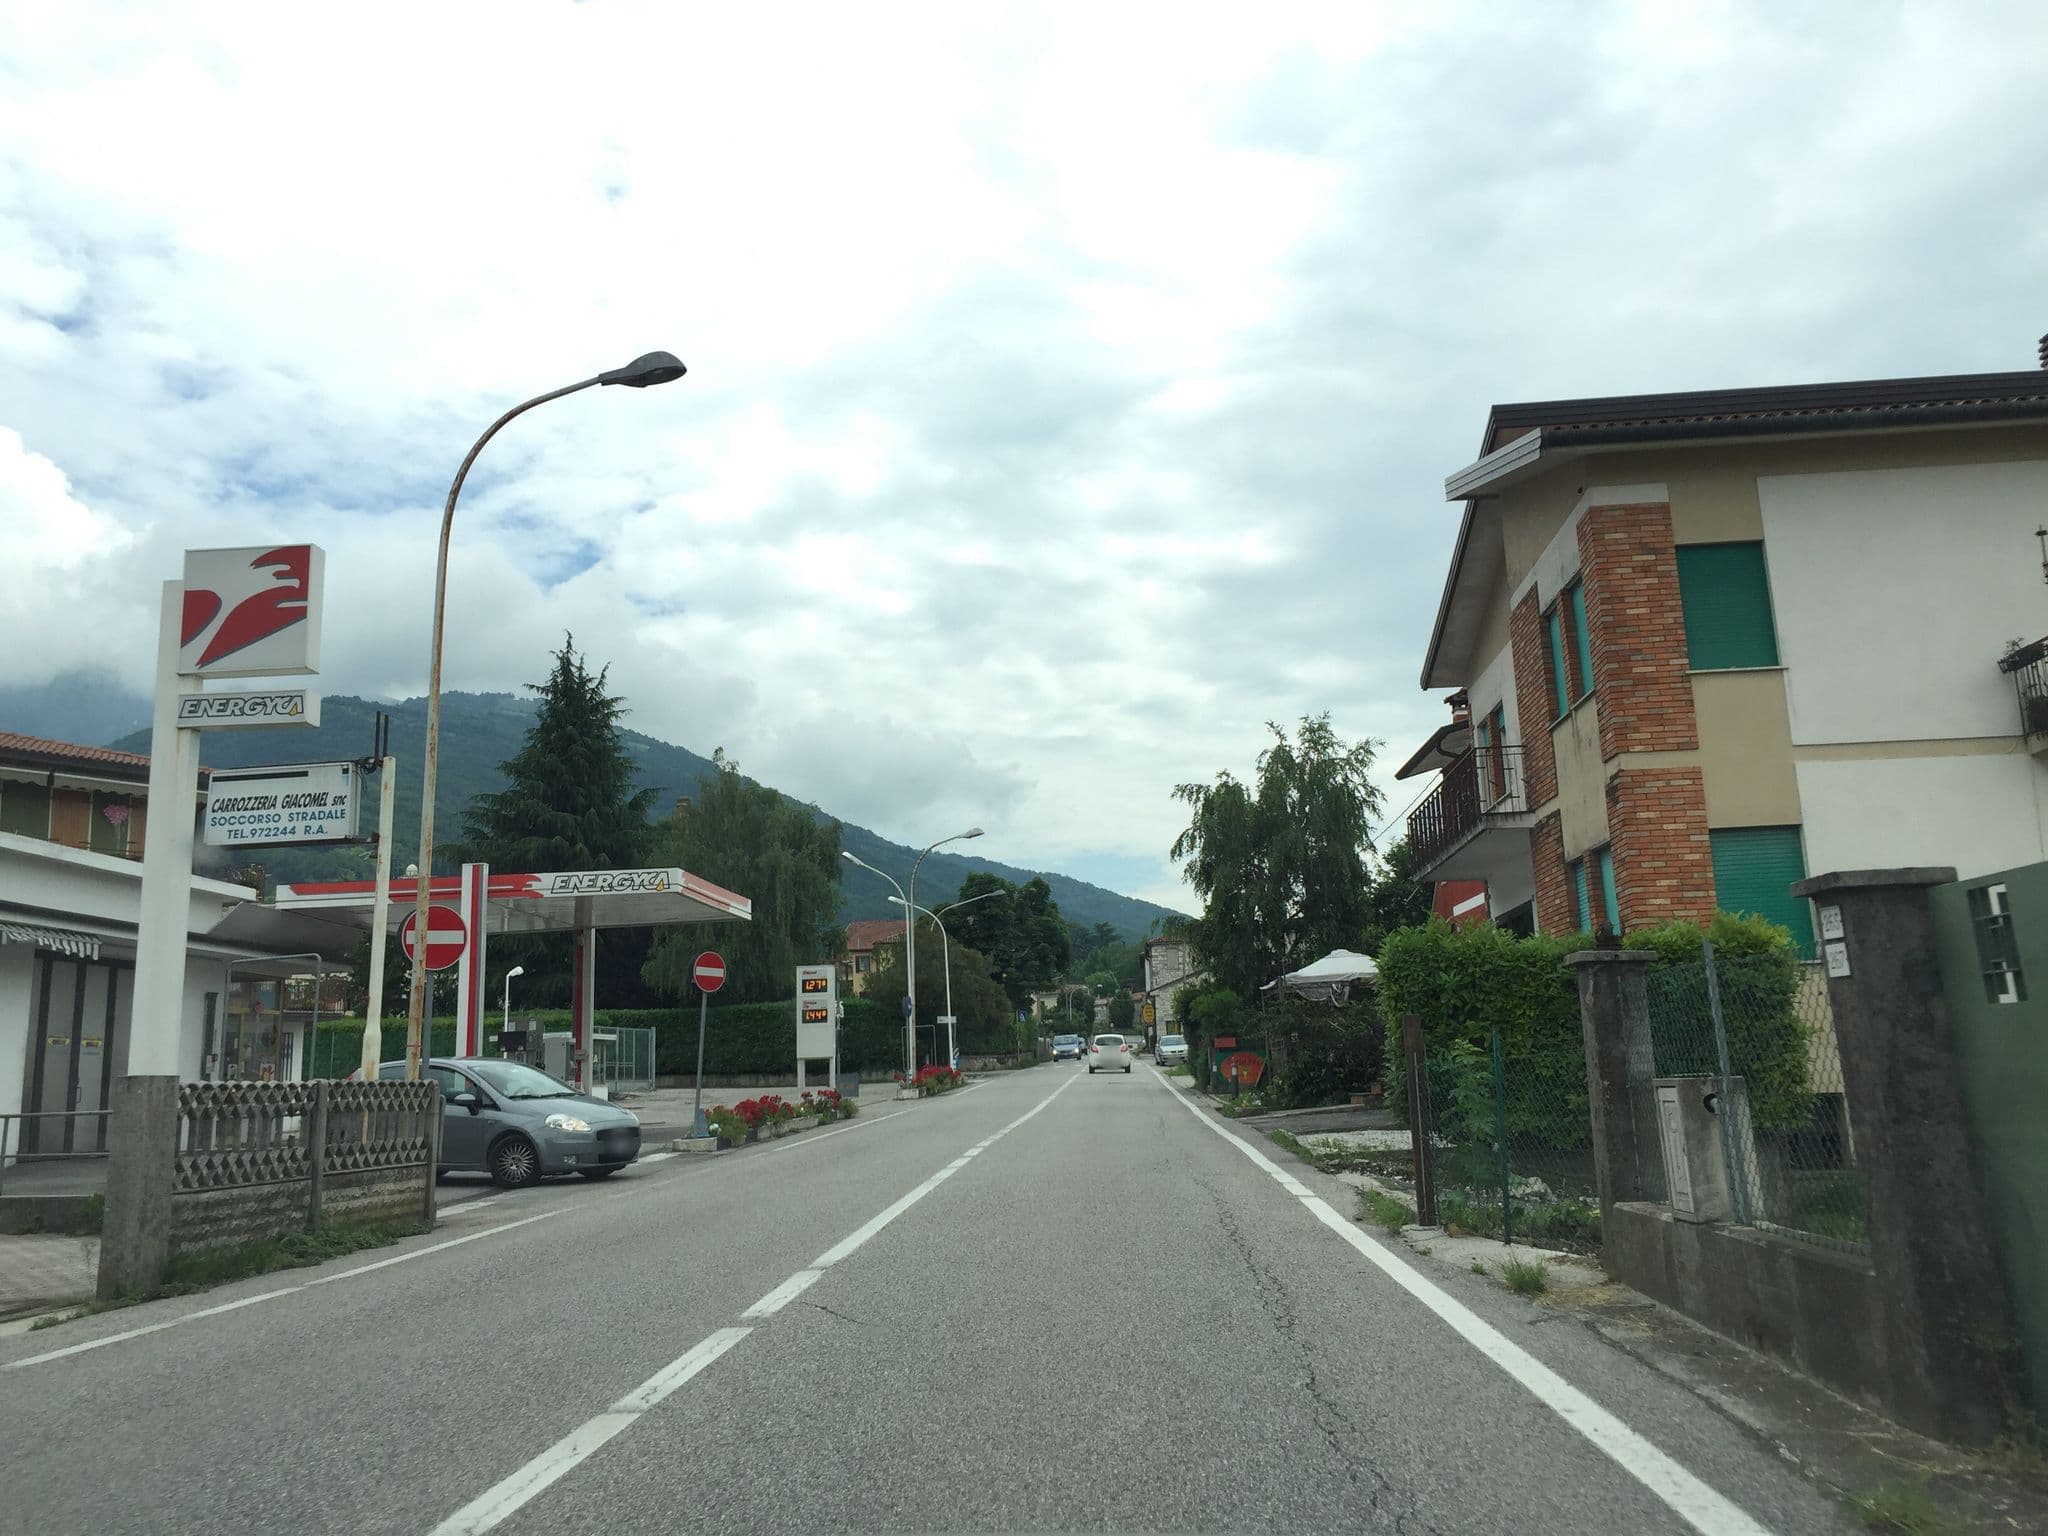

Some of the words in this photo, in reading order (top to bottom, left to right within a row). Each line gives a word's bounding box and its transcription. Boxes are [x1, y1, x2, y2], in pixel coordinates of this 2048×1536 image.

[179, 695, 304, 719] ENERGYCA
[211, 795, 278, 813] CARROZZERIA
[281, 792, 329, 809] GIACOMEL
[331, 794, 347, 806] snc
[210, 813, 282, 827] SOCCORSO
[287, 809, 346, 822] STRADALE
[227, 826, 296, 839] TEL.972244
[304, 824, 328, 835] R.A.
[550, 870, 670, 894] ENERGYCA
